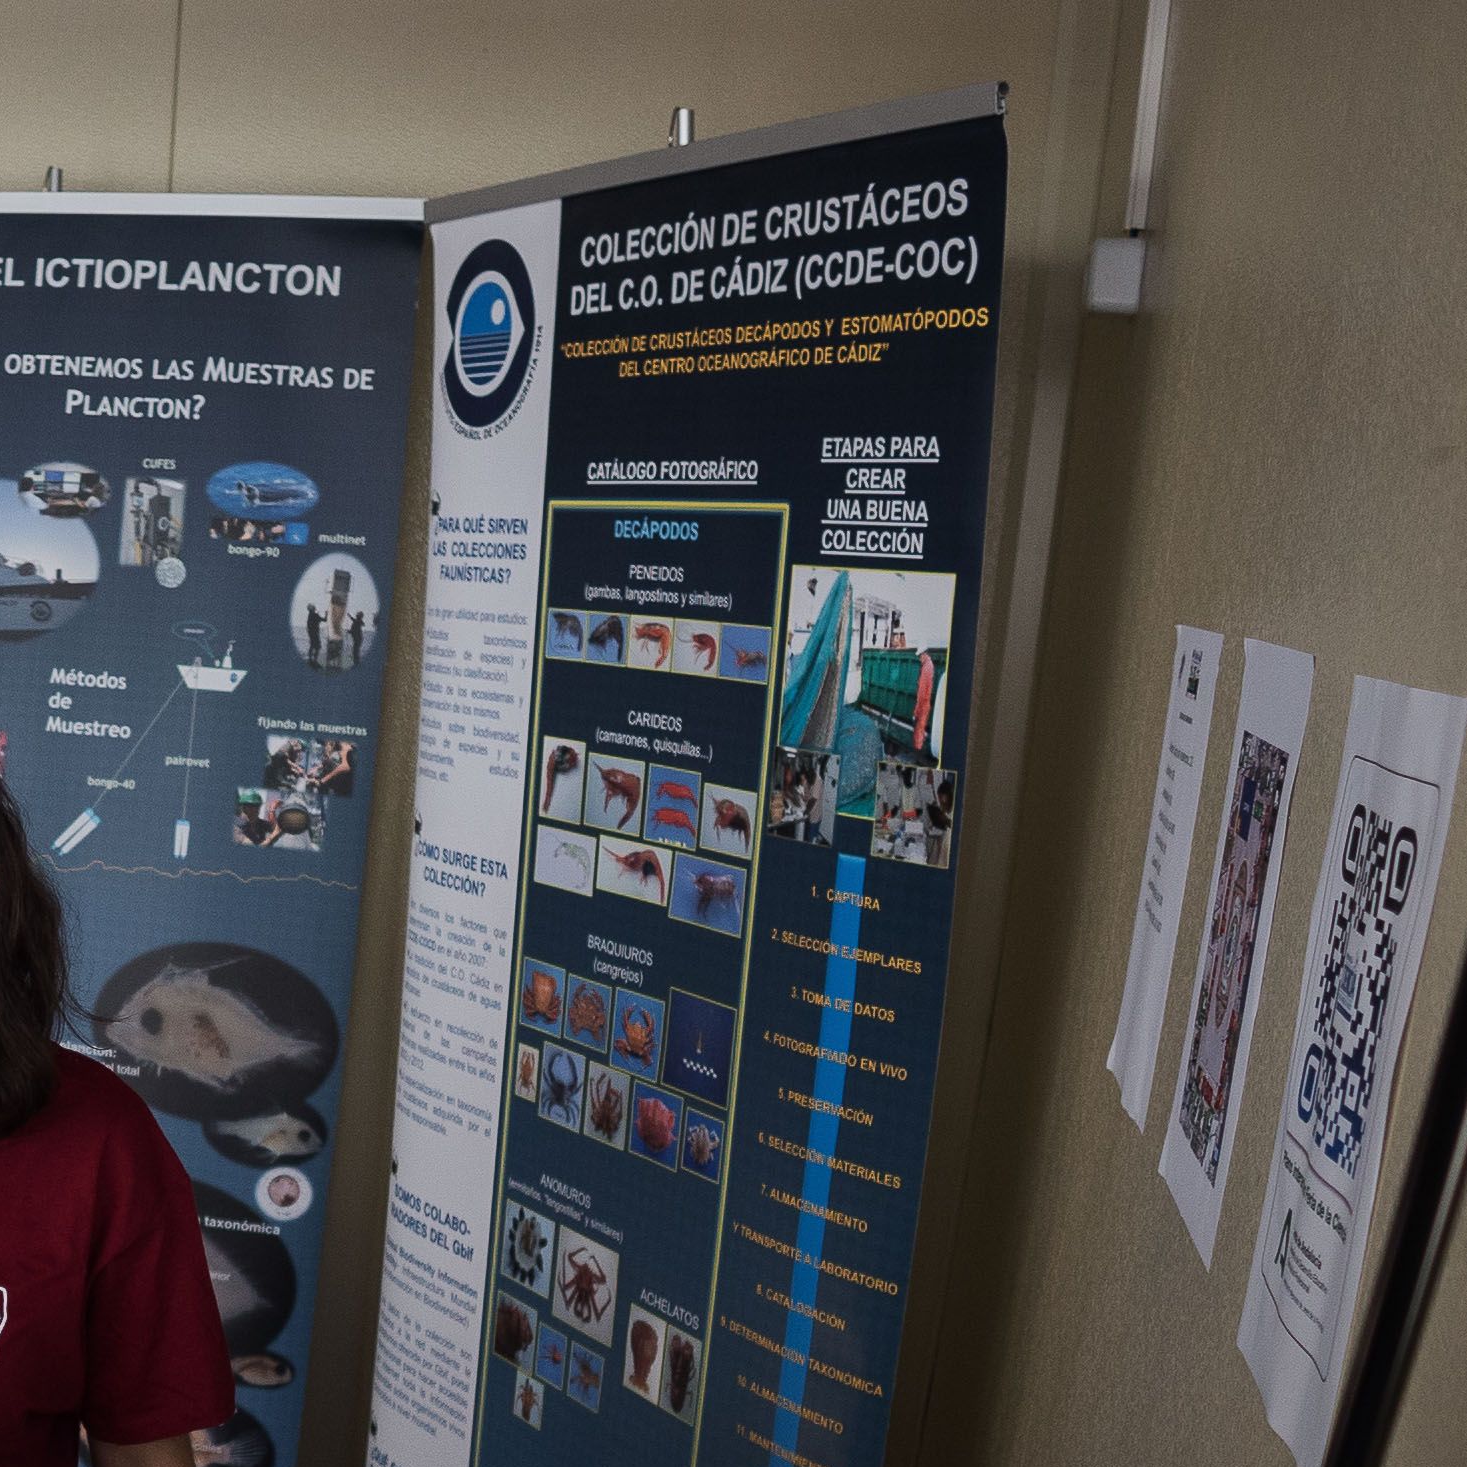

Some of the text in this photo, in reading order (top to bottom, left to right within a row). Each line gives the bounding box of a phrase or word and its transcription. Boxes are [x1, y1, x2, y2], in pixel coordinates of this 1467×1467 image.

[580, 178, 969, 268] COLECCIÓN DE CRUSTÁCEOS
[35, 257, 341, 296] ICTIOPLANCTON
[570, 235, 979, 316] DEL C.O. DE CÁDIZ (CCDE-COC)
[632, 335, 647, 353] DE
[650, 326, 732, 351] CRUSTÁCEOS
[735, 319, 821, 344] DECÁPODOS
[824, 319, 834, 336] Y
[841, 307, 989, 336] ESTOMATÓPODOS
[619, 359, 641, 378] DEL
[644, 356, 694, 376] CENTRO
[698, 347, 810, 373] OCEANOGRÁFICO
[814, 348, 833, 364] DE
[152, 358, 195, 382] LAS
[343, 368, 375, 391] DE
[822, 436, 940, 458] ETAPAS PARA
[142, 458, 176, 469] CUFES
[587, 456, 758, 481] CATÁLOGO FOTOGRÁFICO
[846, 468, 906, 489] CREAR
[827, 498, 928, 521] UNA BUENA
[463, 514, 486, 534] QUÉ
[488, 517, 528, 536] SIRVEN
[614, 516, 699, 541] DECÁPODOS
[228, 543, 280, 558] bongo-90
[319, 533, 366, 546] multinet
[451, 541, 527, 561] COLECCIONES
[821, 527, 924, 554] COLECCIÓN
[440, 564, 512, 585] FAUNÍSTICAS?
[629, 564, 684, 583] PENEIDOS
[585, 585, 733, 611] (gambas, langostinos y similares)
[50, 668, 127, 690] Métodos
[48, 692, 72, 709] de
[46, 716, 131, 739] Muestreo
[258, 716, 367, 736] fijando las muestras
[628, 710, 682, 732] CARIDEOS
[596, 727, 651, 749] (camarones,
[826, 889, 881, 911] CAPTURA
[587, 934, 653, 966] BRAQUIUROS
[782, 931, 838, 956] SELECCIÓN
[842, 946, 922, 975] EJEMPLARES
[593, 958, 644, 986] (cangrejos)
[802, 988, 831, 1008] TOMA
[835, 998, 851, 1012] DE
[855, 1002, 896, 1023] DATOS
[860, 1058, 877, 1072] EN
[880, 1064, 907, 1081] VIVO
[540, 1174, 591, 1210] ANOMUROS
[204, 1215, 281, 1236] taxonómica
[640, 1288, 700, 1330] ACHELATOS
